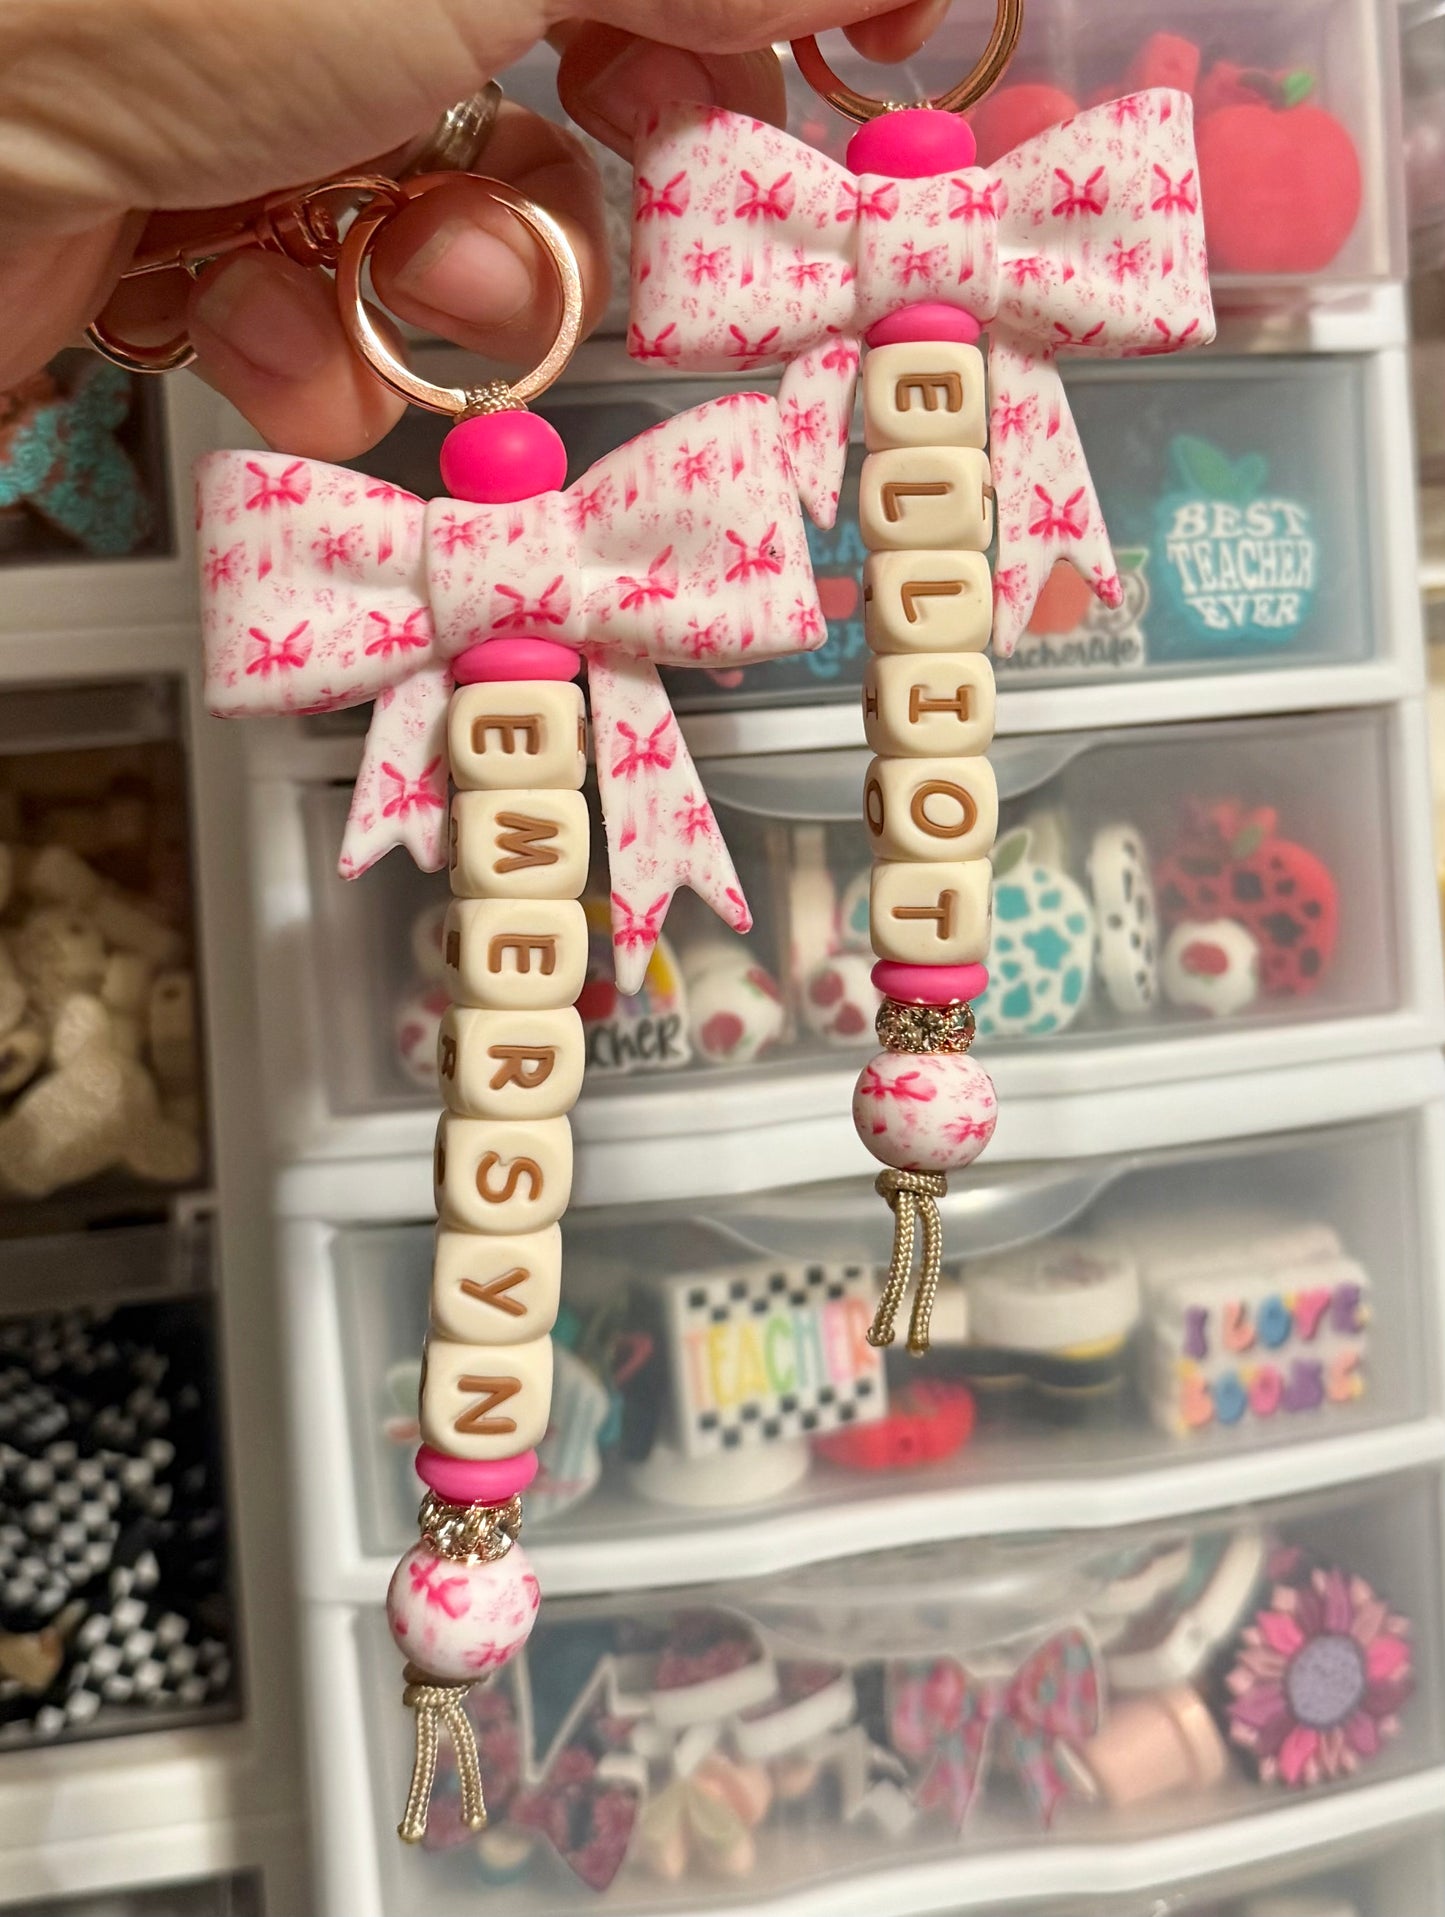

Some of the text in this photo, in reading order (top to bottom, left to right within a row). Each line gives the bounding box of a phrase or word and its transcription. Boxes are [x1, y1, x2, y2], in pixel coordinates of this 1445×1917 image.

[1166, 501, 1310, 543] BEST
[1166, 539, 1315, 595] TEACHER
[1185, 593, 1300, 631] EVER
[880, 371, 978, 940] ELLIOT
[453, 714, 559, 1434] EMERSYN
[683, 1296, 879, 1413] TEACHER
